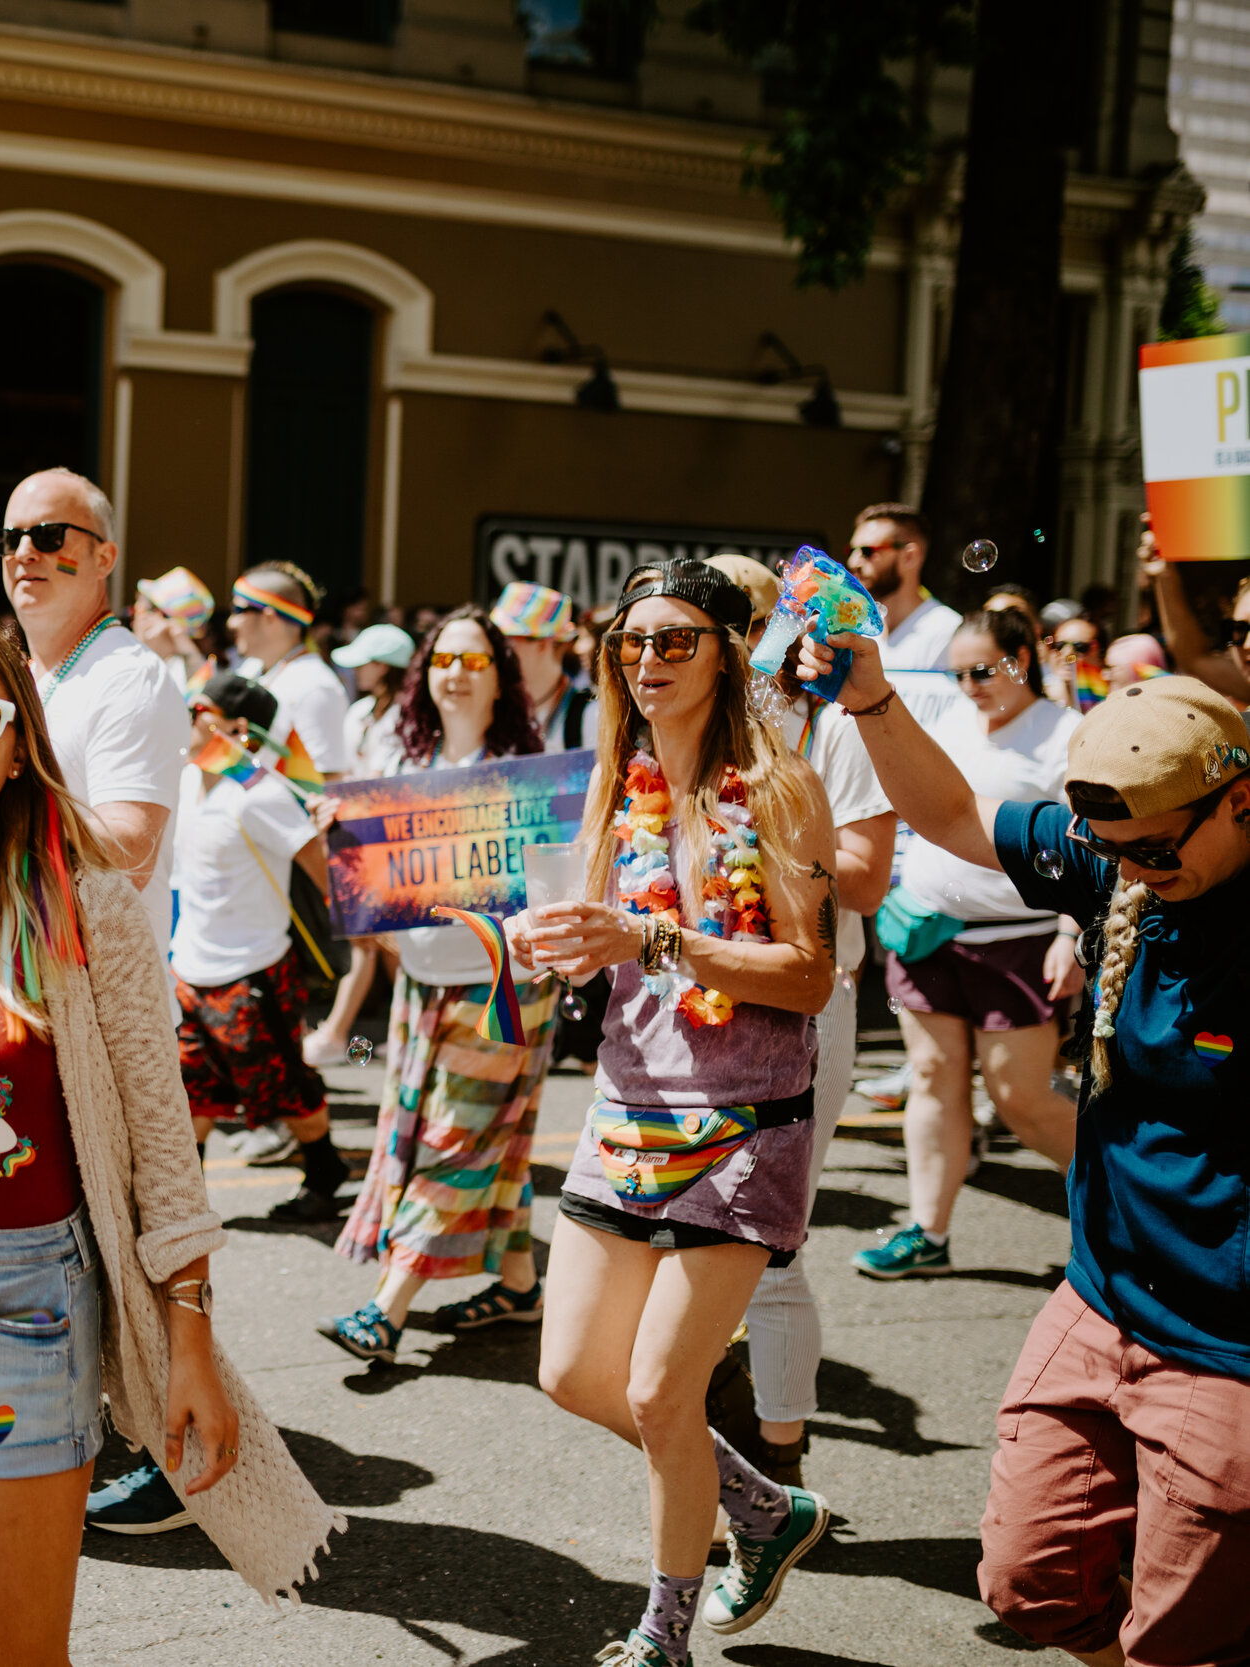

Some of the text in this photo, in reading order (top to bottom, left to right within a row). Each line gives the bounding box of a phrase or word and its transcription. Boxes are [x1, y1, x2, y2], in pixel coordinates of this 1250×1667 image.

[1216, 371, 1250, 443] P
[383, 814, 411, 841] WE
[413, 803, 509, 838] ENCOURAGE
[389, 847, 442, 887] NOT
